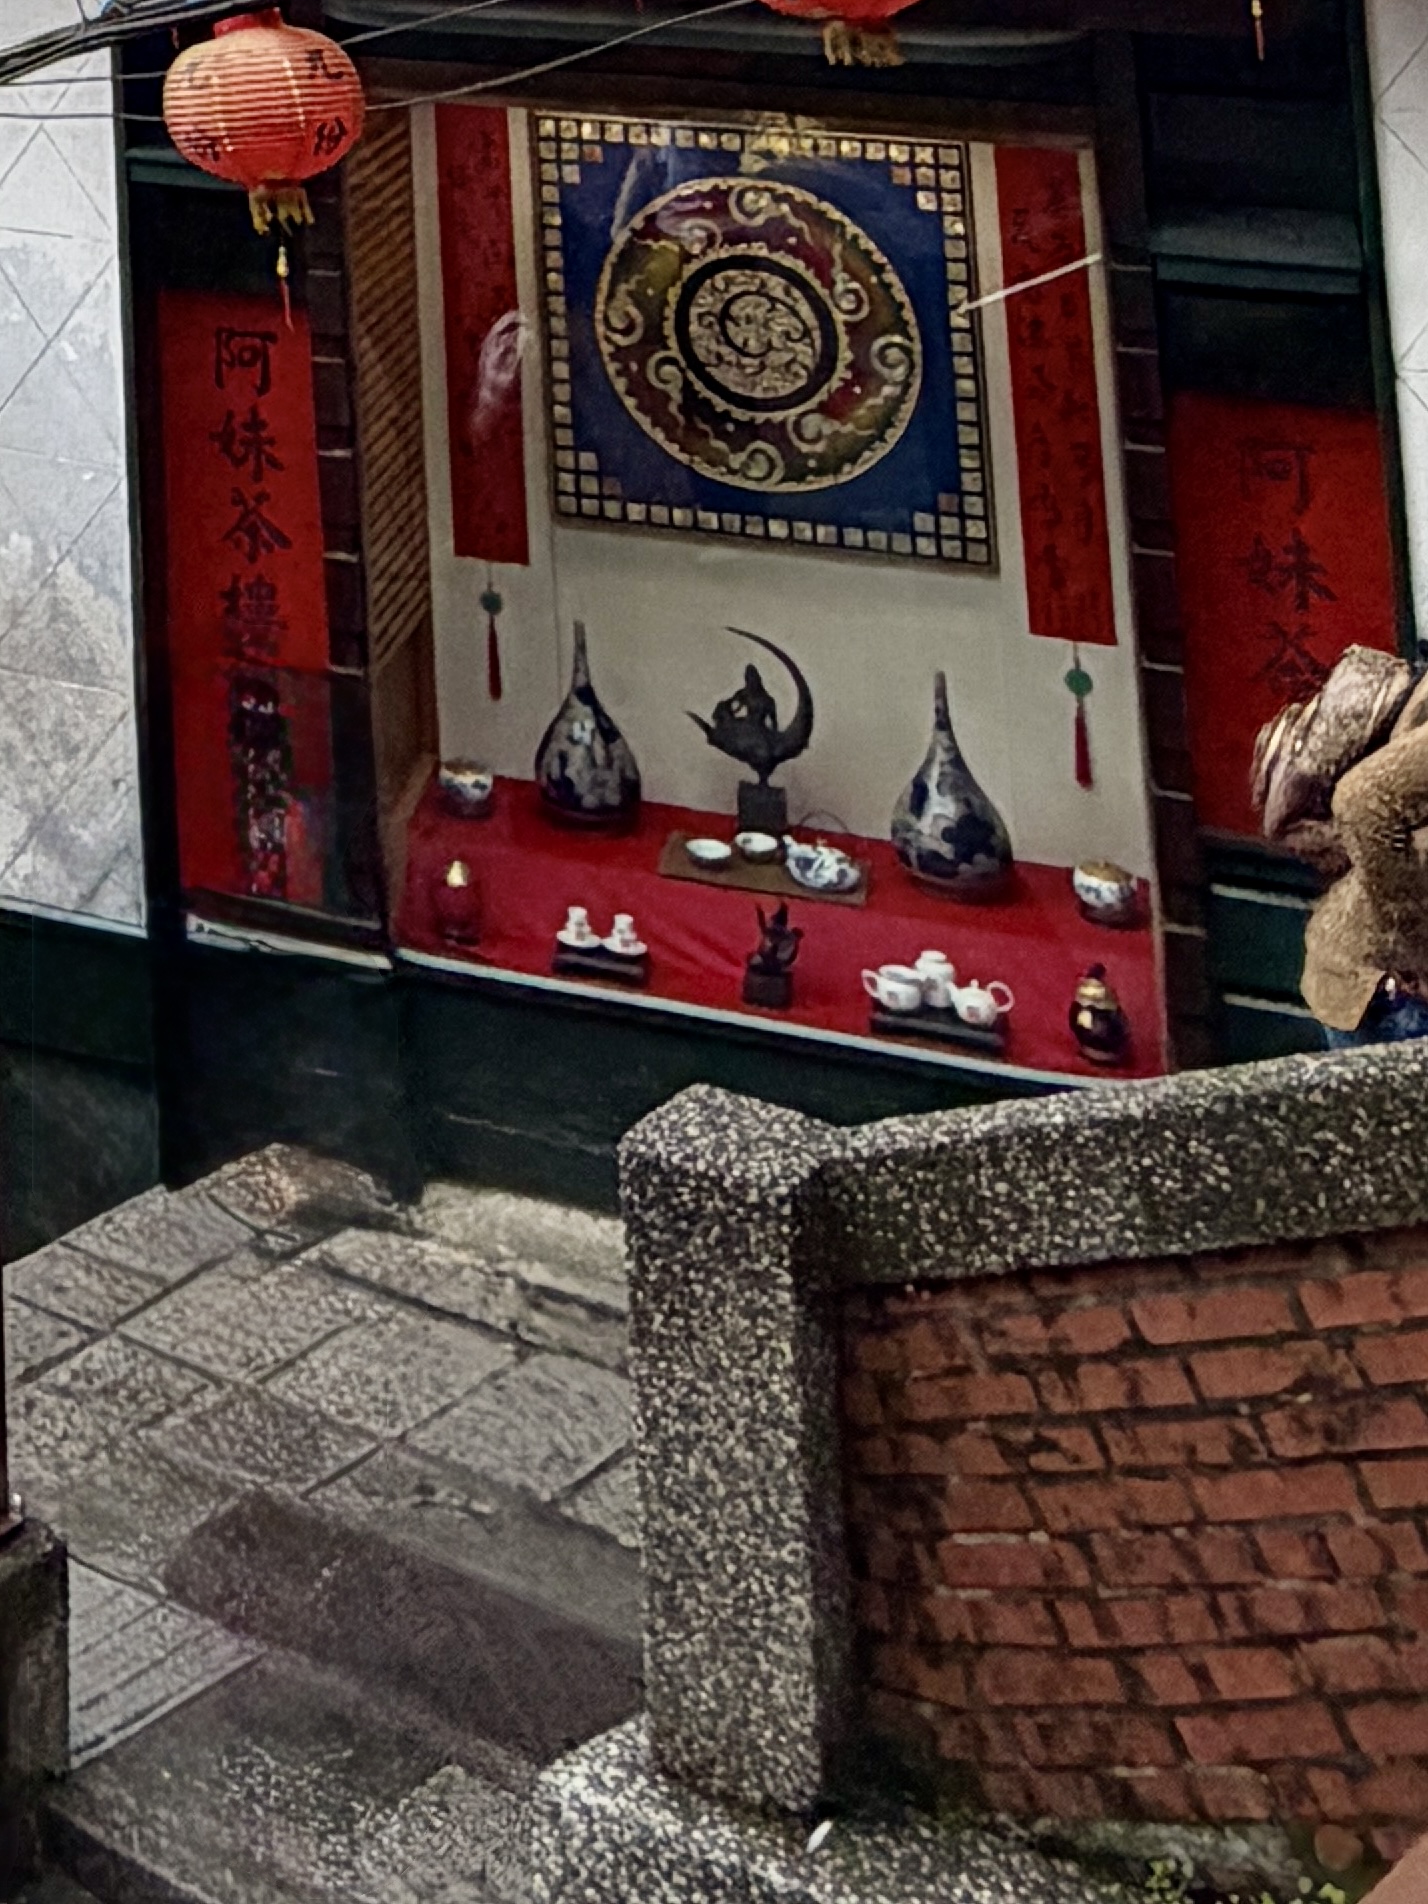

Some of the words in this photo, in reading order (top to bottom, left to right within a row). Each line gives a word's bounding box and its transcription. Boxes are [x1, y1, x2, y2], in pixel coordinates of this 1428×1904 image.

[305, 48, 348, 156] 九份
[209, 327, 293, 658] 阿妹茶樓
